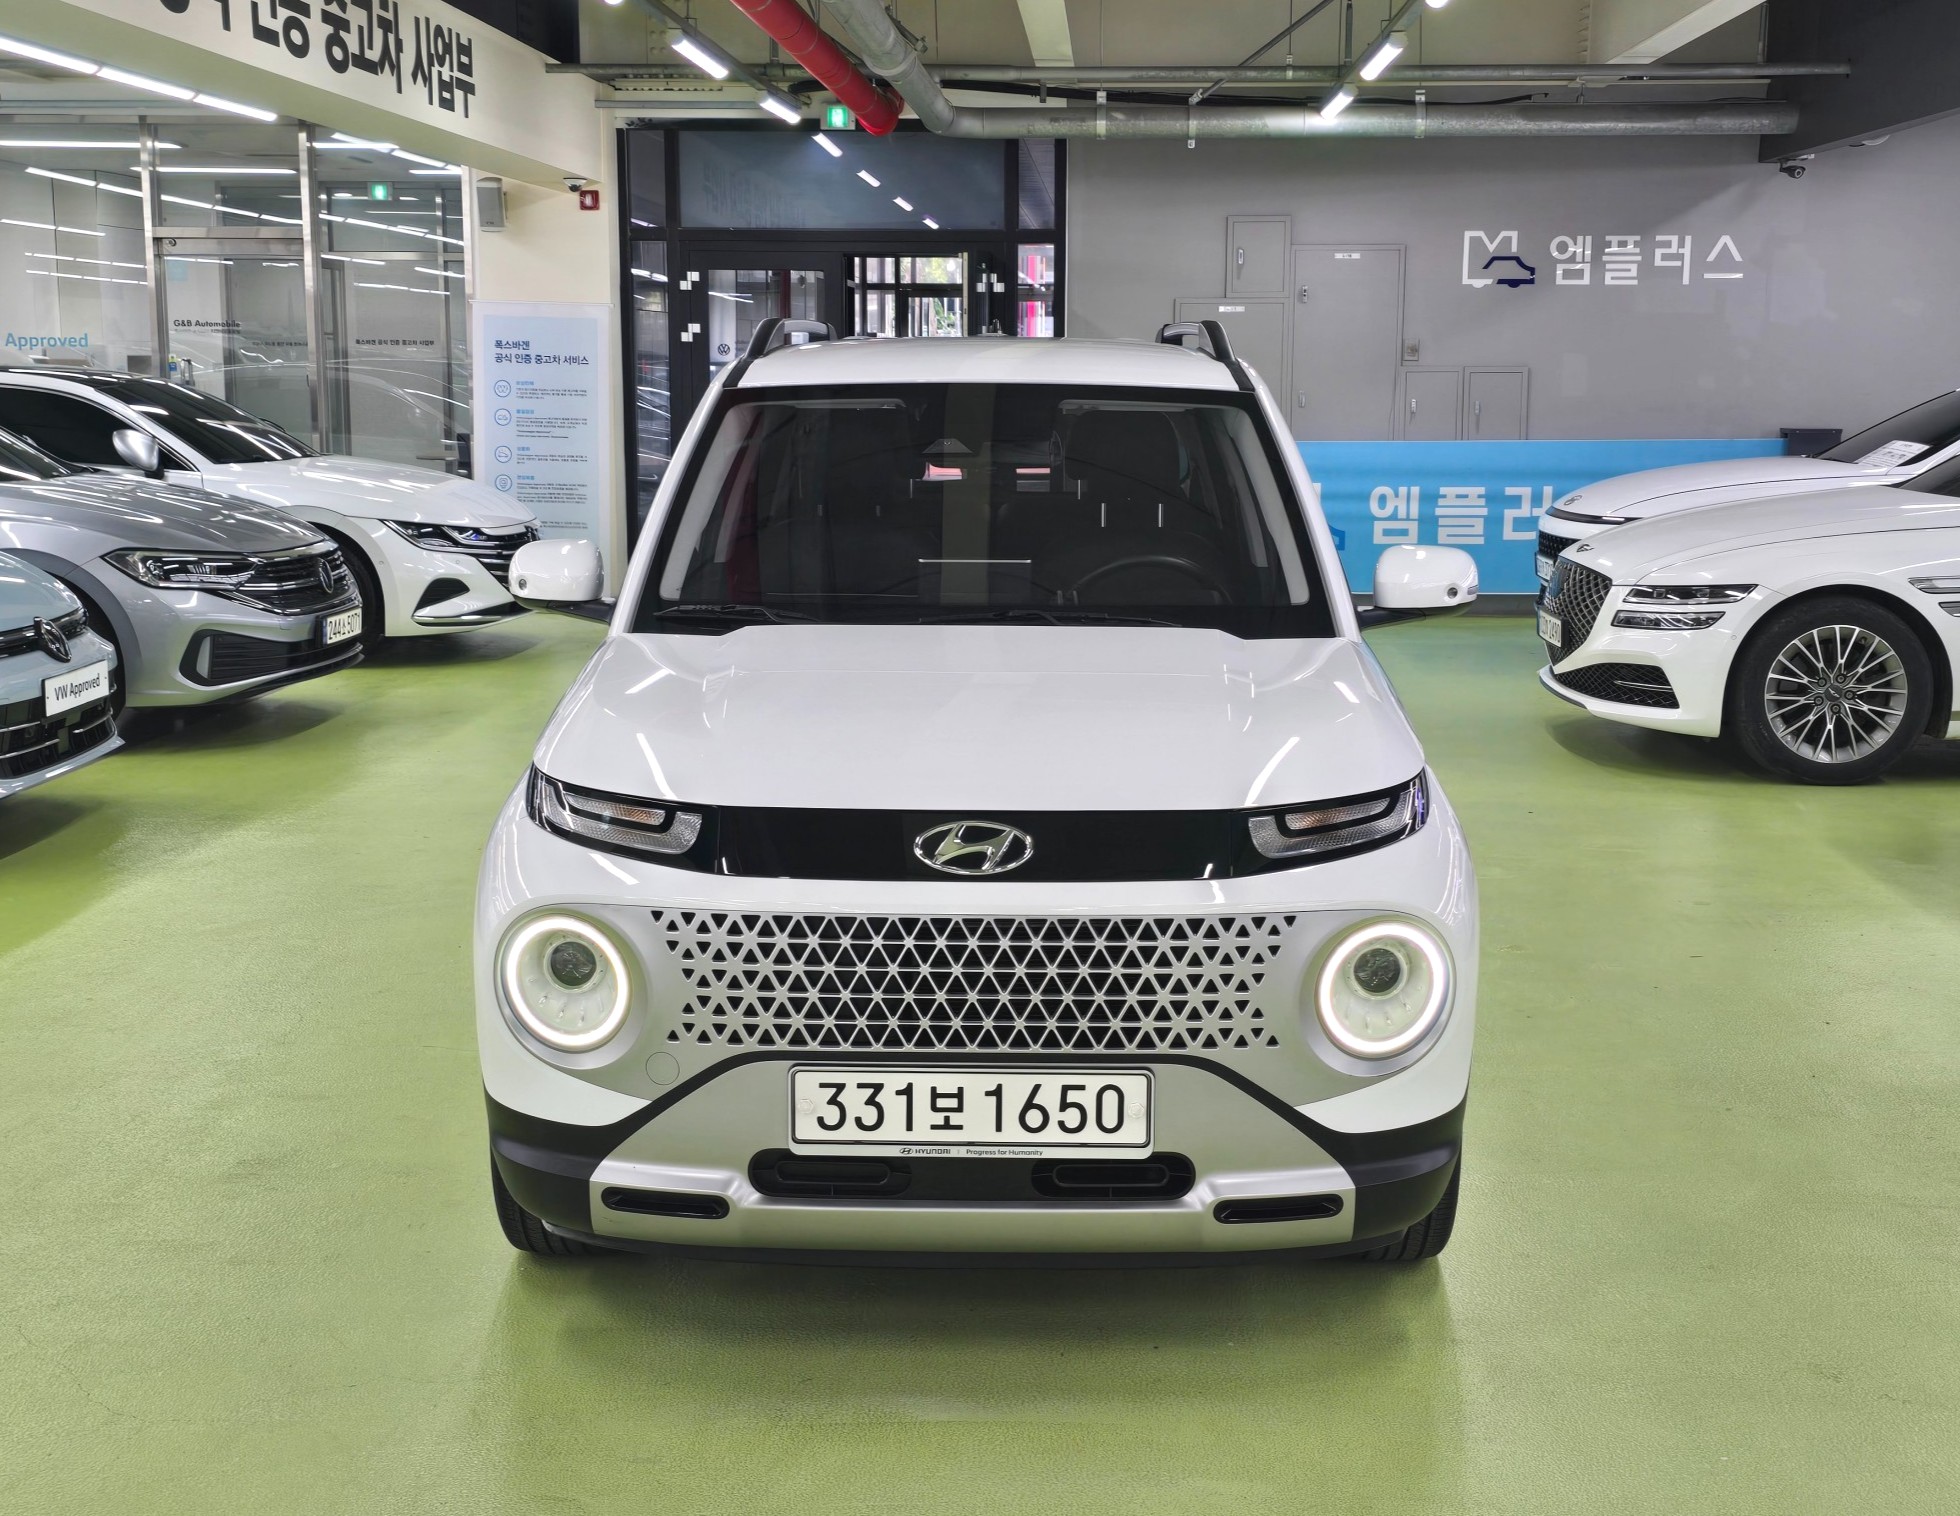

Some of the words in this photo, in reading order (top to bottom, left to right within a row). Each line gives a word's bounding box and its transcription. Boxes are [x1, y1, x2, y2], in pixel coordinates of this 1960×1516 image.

[411, 15, 476, 119] 사업부
[1549, 235, 1744, 285] 엠플러스
[173, 319, 193, 328] G&B
[194, 319, 241, 328] Automobile
[5, 332, 89, 350] Approved
[494, 340, 531, 351] 폭스바겐
[494, 353, 513, 364] 공식
[514, 353, 532, 364] 인증
[534, 354, 561, 365] 중고차
[563, 355, 590, 365] 서비스
[54, 683, 68, 701] VW
[69, 672, 100, 698] Approved
[816, 1081, 964, 1132] 331보
[984, 1082, 1125, 1134] 1650
[966, 1148, 996, 1156] Progress
[1008, 1149, 1044, 1157] Humanity
